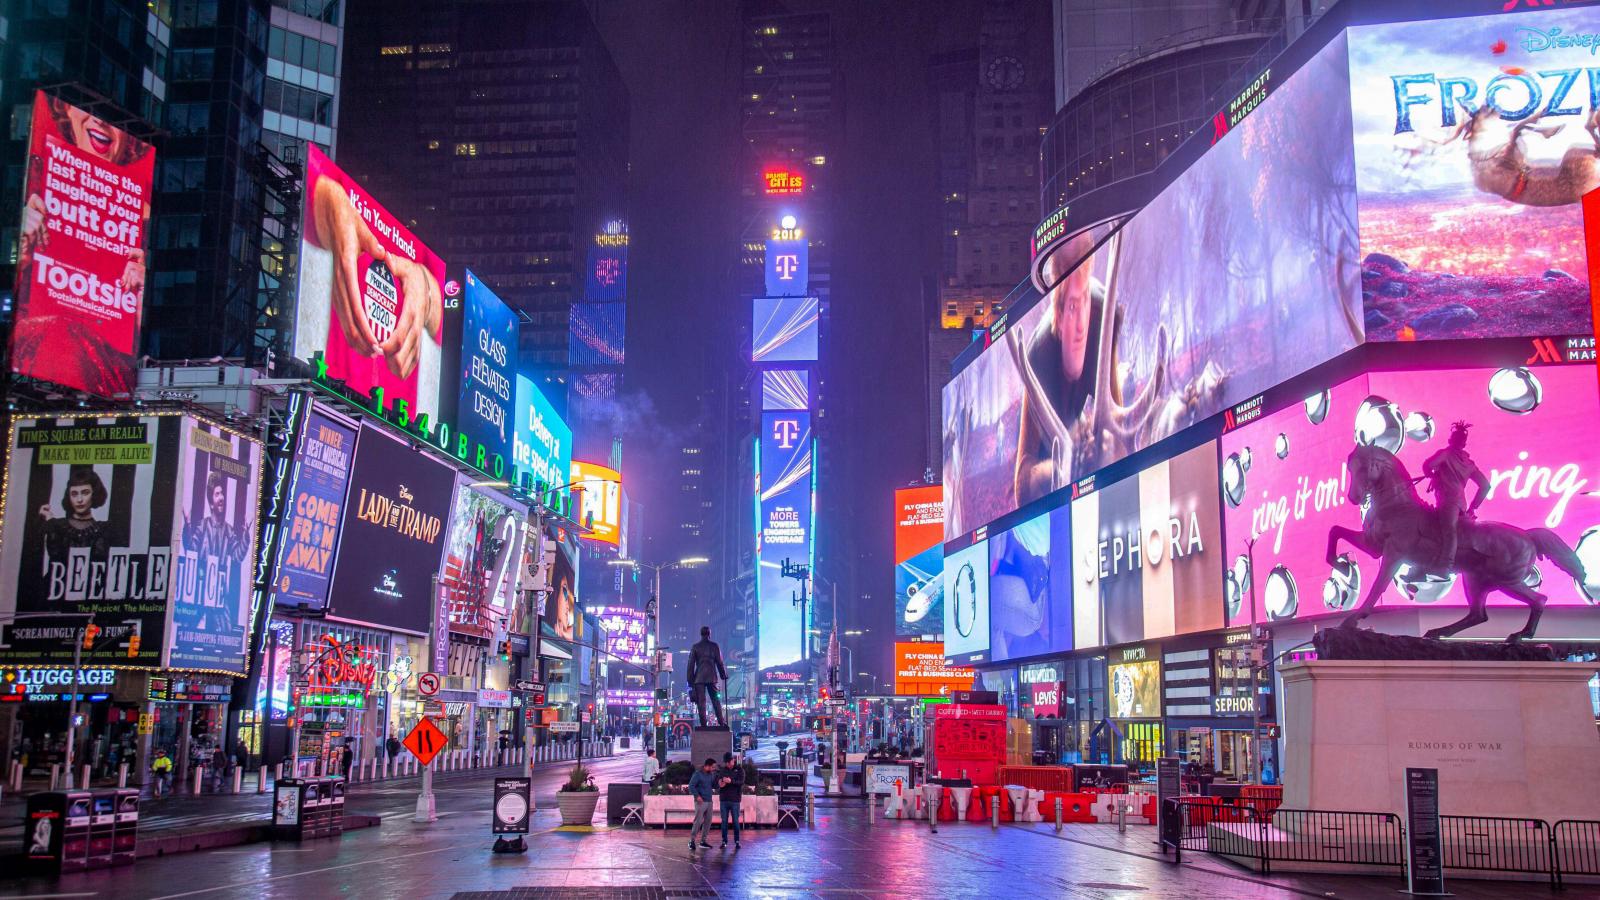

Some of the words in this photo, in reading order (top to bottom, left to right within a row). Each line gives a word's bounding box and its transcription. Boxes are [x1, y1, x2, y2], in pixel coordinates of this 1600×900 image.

[1230, 69, 1270, 112] MARRIOTT
[1231, 89, 1266, 126] MARQUIS
[47, 157, 75, 181] last
[80, 172, 112, 197] time
[116, 188, 141, 210] you
[94, 166, 119, 186] was
[121, 175, 142, 195] the
[47, 173, 107, 210] laughed
[108, 201, 141, 225] your
[45, 190, 100, 232] butt
[103, 215, 139, 246] off
[47, 218, 61, 232] at
[64, 225, 72, 236] a
[350, 188, 362, 213] It's
[364, 200, 371, 222] in
[373, 208, 391, 237] Your
[392, 226, 416, 260] Hands
[1036, 207, 1069, 238] MARRIOTT
[773, 230, 800, 240] 2019
[1037, 222, 1065, 251] MARQUIS
[33, 253, 137, 313] Tootsie
[48, 287, 122, 319] TootsieMusical.com
[367, 286, 395, 313] DEMOCRACY
[372, 302, 389, 327] 2020
[445, 299, 459, 309] LG
[479, 329, 506, 366] GLASS
[472, 355, 509, 401] ELEVATES
[474, 390, 506, 433] DESIGN
[1236, 395, 1264, 414] MARRIOTT
[1237, 407, 1261, 425] MARQUIS
[22, 430, 49, 443] TIMES
[51, 429, 86, 442] SQUARE
[88, 428, 106, 441] CAN
[110, 427, 144, 440] REALLY
[43, 448, 70, 461] MAKE
[73, 448, 91, 460] YOU
[94, 447, 117, 459] FEEL
[306, 437, 323, 460] BEST
[322, 444, 347, 471] MUSICAL
[531, 449, 548, 482] speed
[1487, 451, 1588, 528] ring
[297, 492, 339, 526] COME
[357, 488, 393, 527] LADY
[770, 512, 799, 520] MORE
[1252, 490, 1290, 555] ring
[1294, 476, 1313, 520] it
[1315, 462, 1347, 512] on!
[291, 516, 335, 550] FROM
[398, 504, 440, 544] TRAMP
[286, 542, 331, 573] AWAY
[1085, 511, 1203, 584] SEPHORA
[48, 552, 167, 600] BEETLE
[124, 604, 137, 612] The
[437, 598, 447, 661] FROZEN
[1123, 647, 1146, 660] INVICTA
[18, 669, 115, 685] LUGGAGE
[25, 685, 42, 694] NY
[1216, 697, 1261, 712] SEPHOR
[1408, 741, 1454, 750] RUMORS
[1459, 742, 1473, 750] OF
[1477, 742, 1503, 751] WAR
[876, 774, 907, 784] FROZEN
